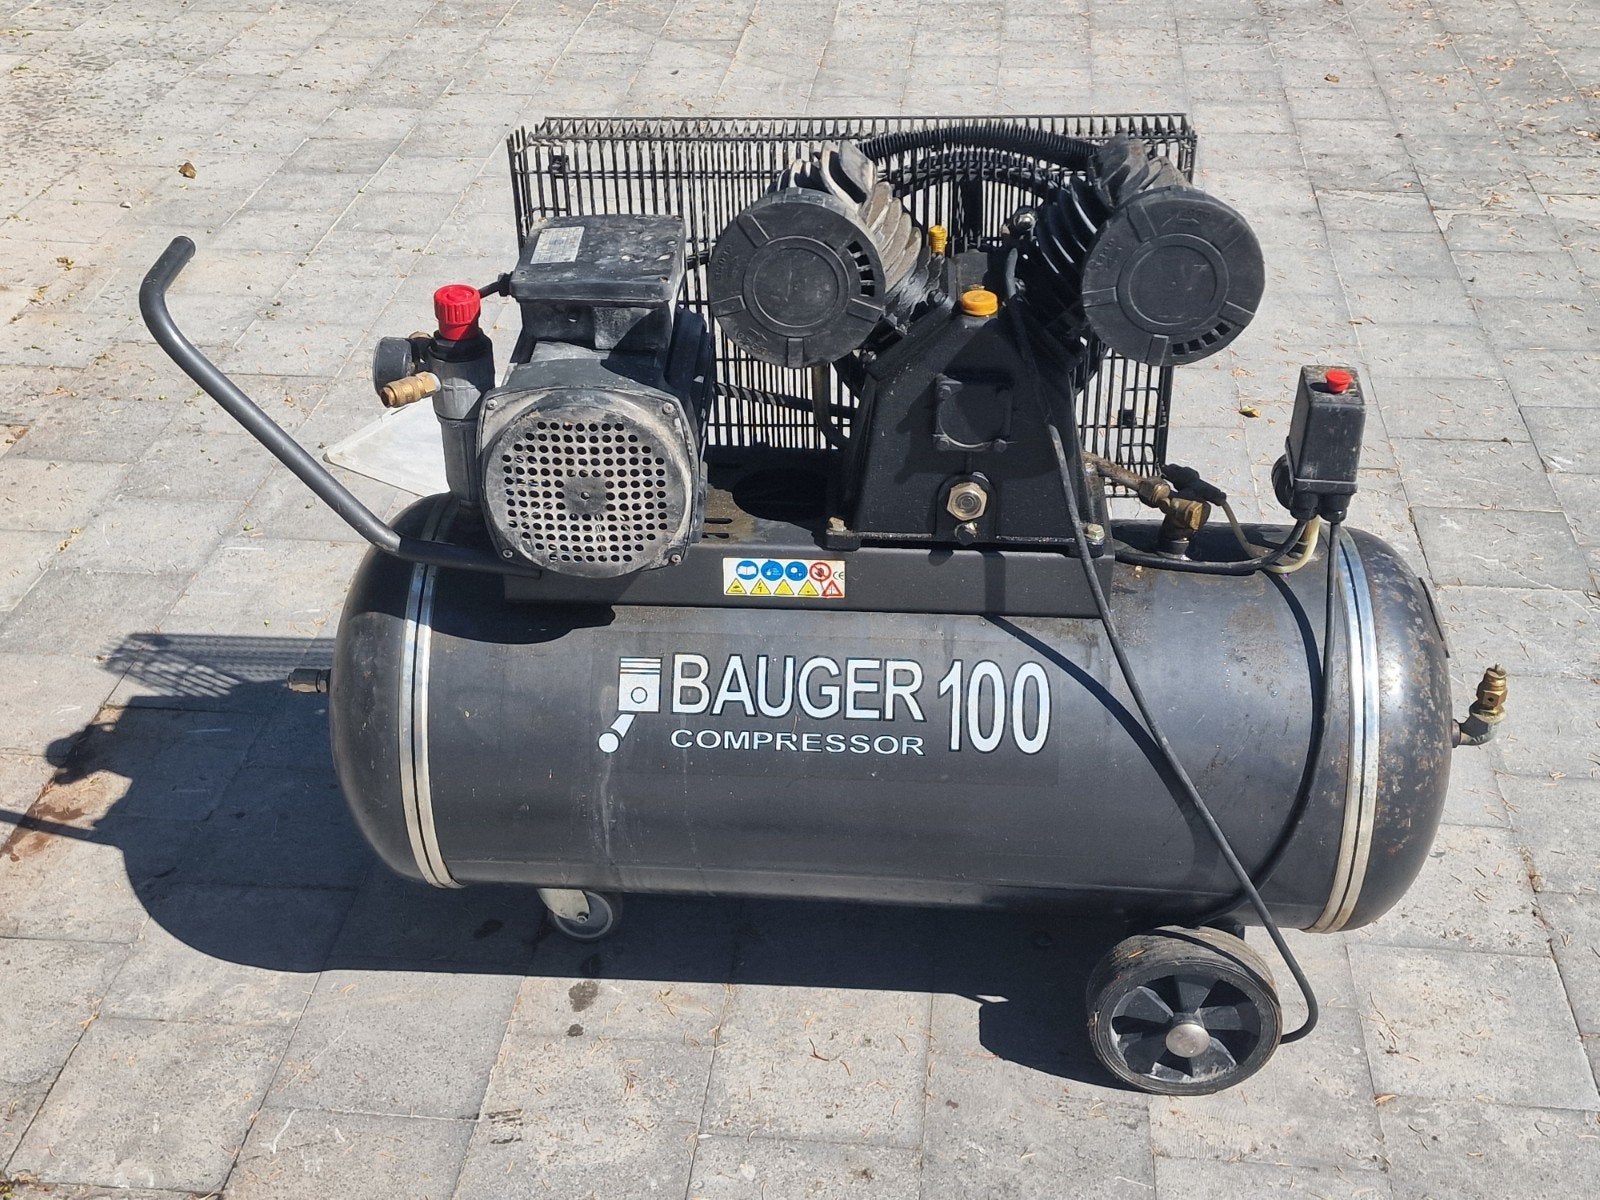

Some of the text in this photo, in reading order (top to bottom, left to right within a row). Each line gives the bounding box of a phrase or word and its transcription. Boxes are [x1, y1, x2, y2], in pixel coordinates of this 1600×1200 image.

[832, 571, 844, 580] CE
[672, 653, 1050, 755] BAUGER 100
[669, 728, 926, 756] COMPRESSOR
